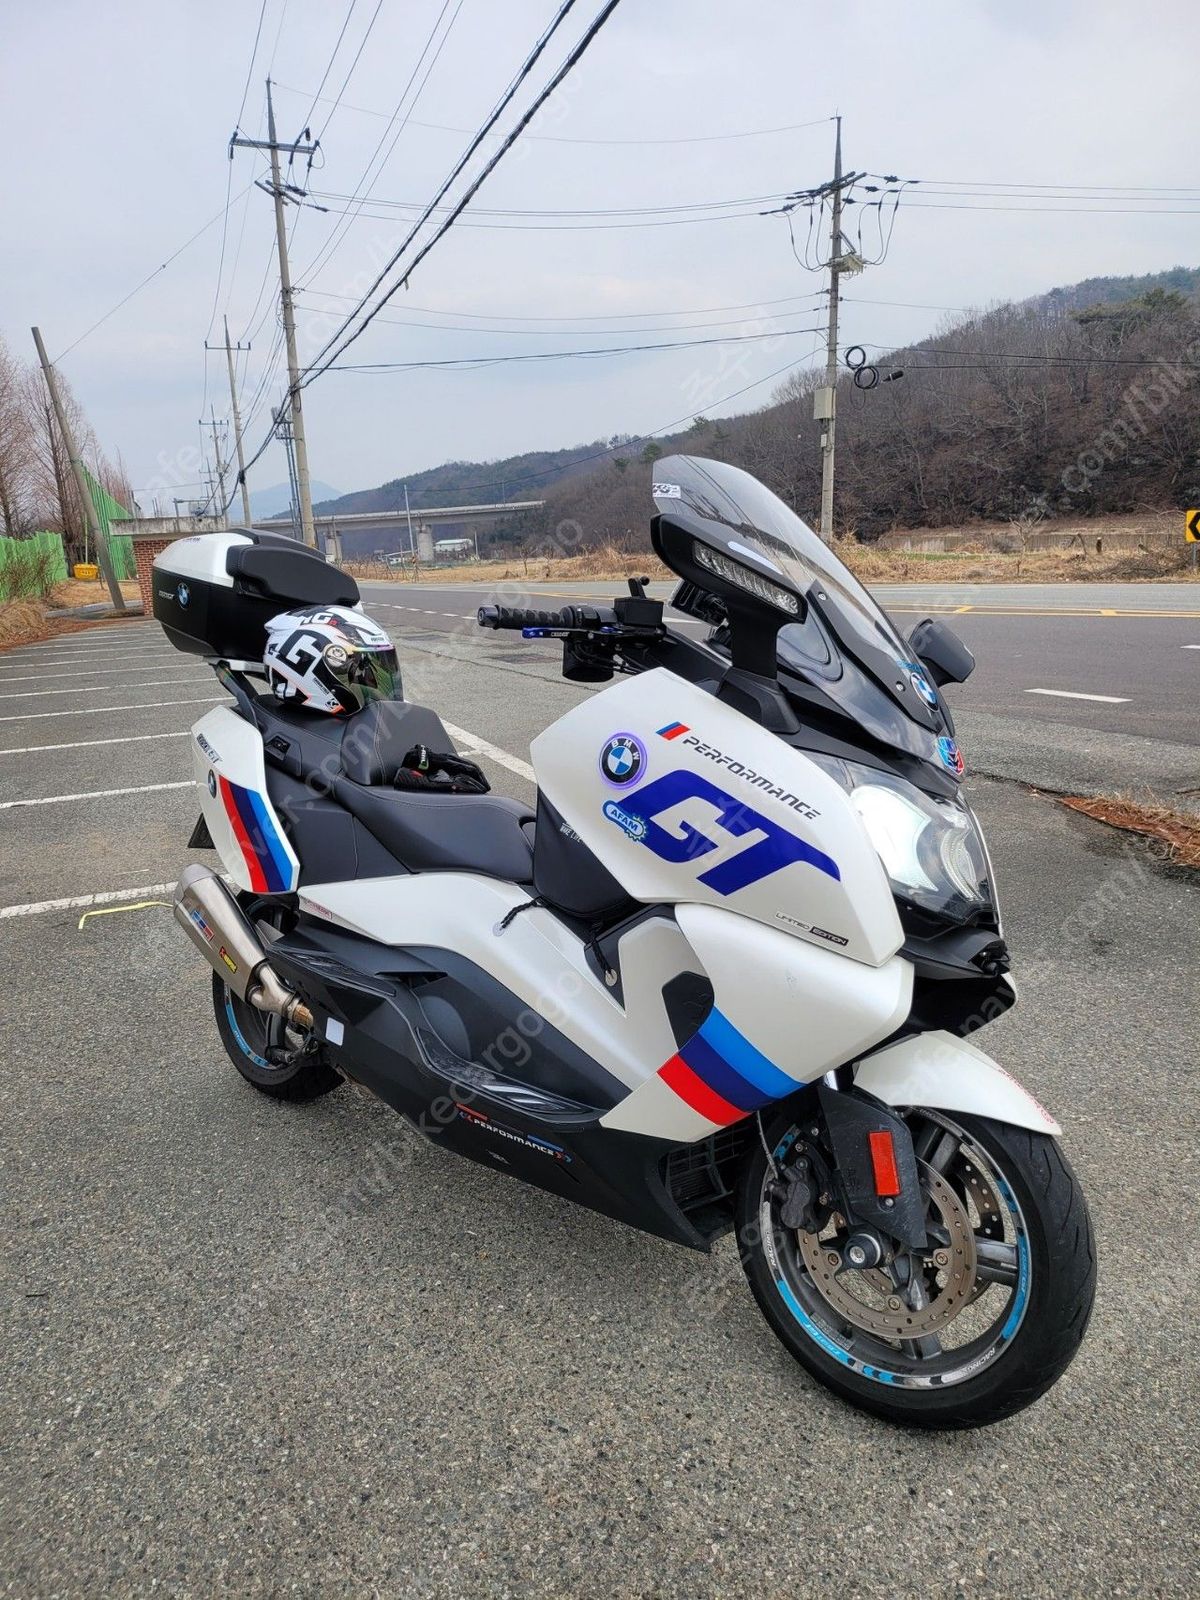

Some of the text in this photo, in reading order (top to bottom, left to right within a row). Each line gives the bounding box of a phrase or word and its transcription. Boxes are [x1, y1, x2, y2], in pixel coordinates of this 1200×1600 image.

[682, 736, 822, 820] PERFORMANCE
[610, 808, 640, 832] AFAM
[614, 769, 842, 897] GT
[775, 912, 849, 946] LIMITED EDITION
[473, 1118, 554, 1156] PERFORMANCE
